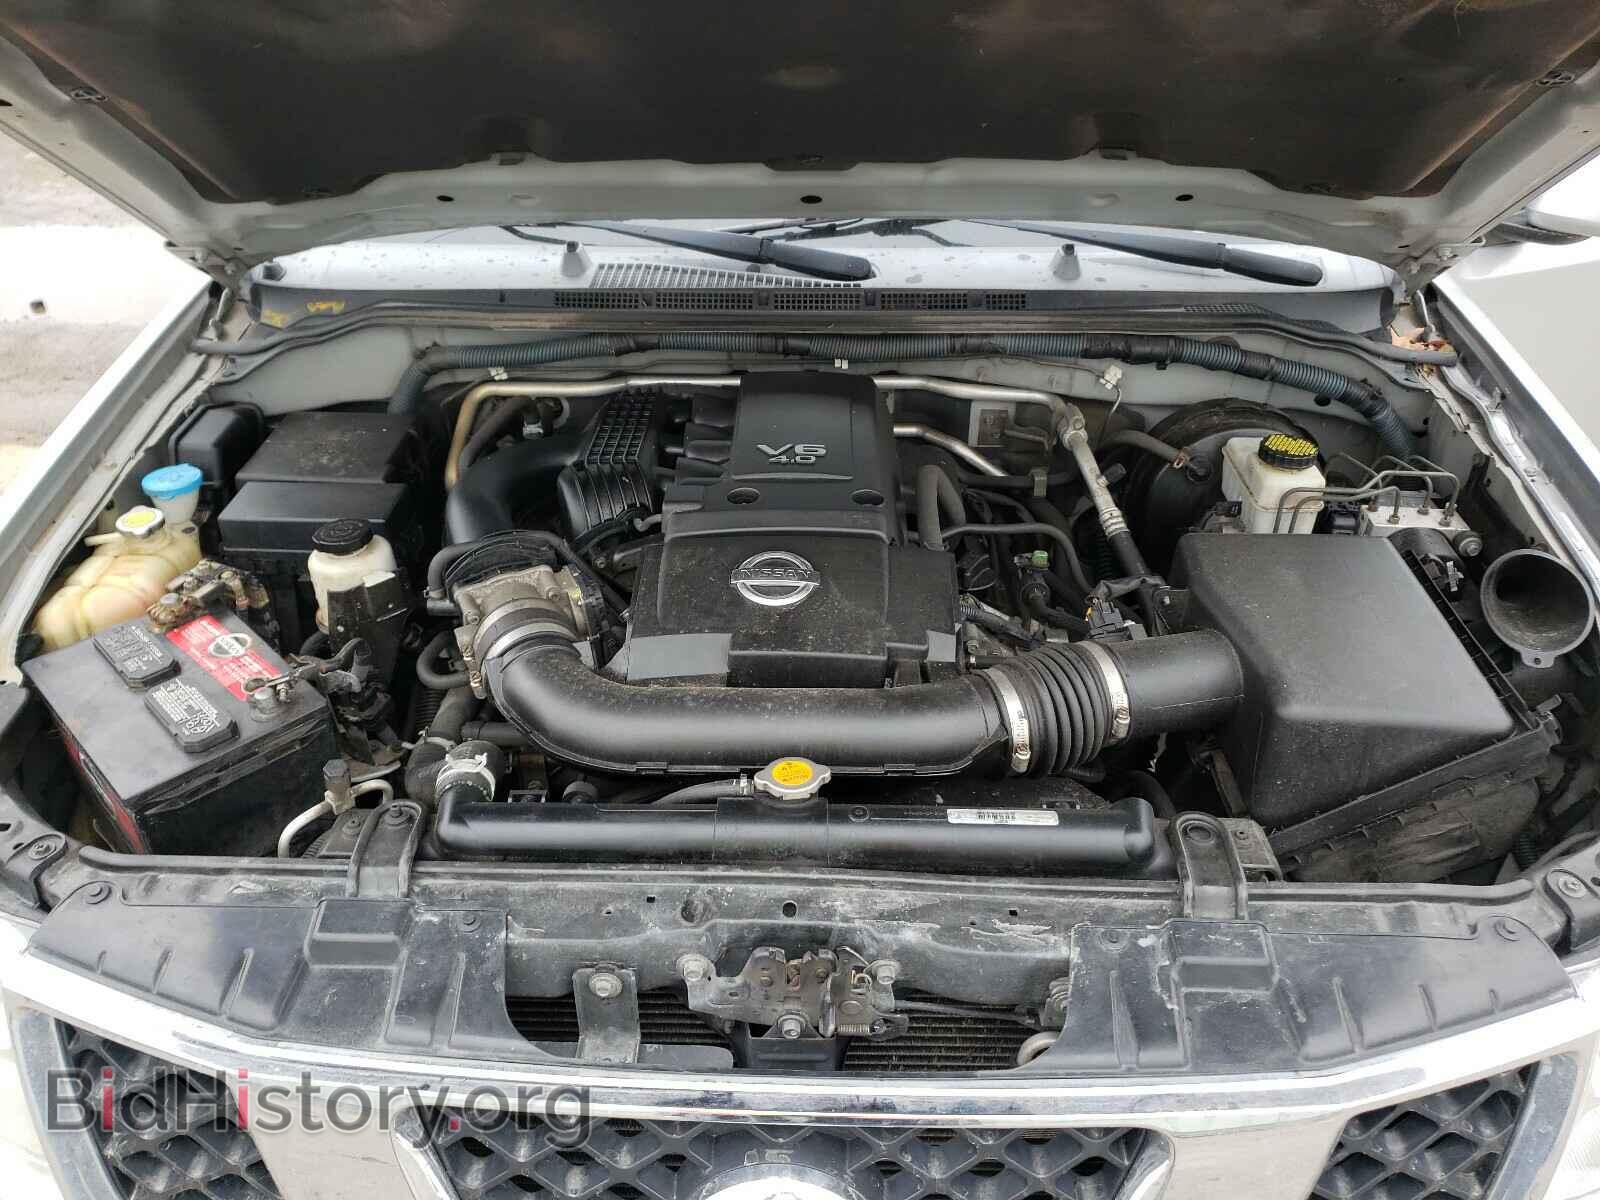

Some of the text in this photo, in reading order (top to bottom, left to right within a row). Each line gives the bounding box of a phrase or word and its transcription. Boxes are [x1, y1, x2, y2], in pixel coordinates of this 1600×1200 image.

[756, 443, 827, 457] V6
[768, 455, 817, 464] 4.0
[739, 567, 813, 580] NISSAN
